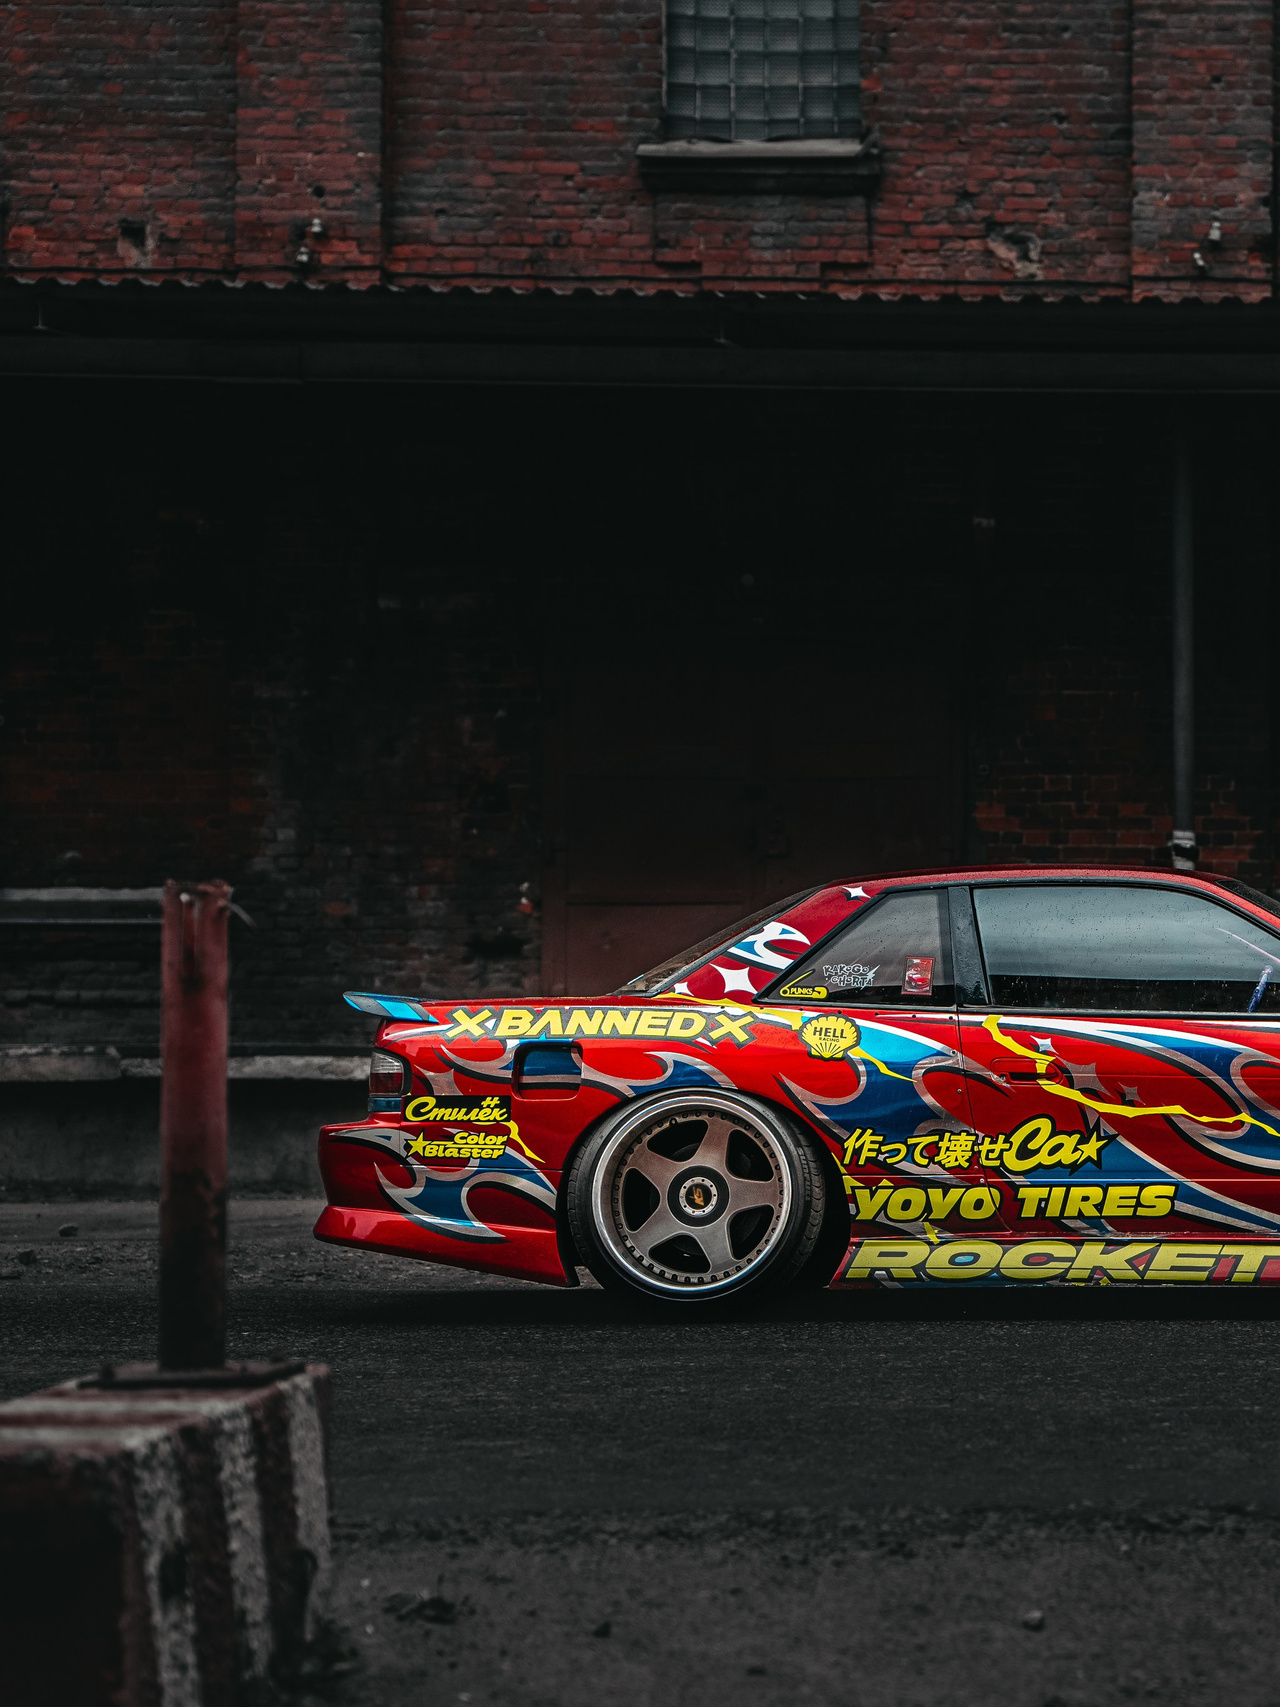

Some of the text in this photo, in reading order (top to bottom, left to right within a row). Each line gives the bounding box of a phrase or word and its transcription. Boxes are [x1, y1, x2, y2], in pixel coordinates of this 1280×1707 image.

[495, 1009, 706, 1038] BANNED
[813, 1026, 848, 1039] HELL
[453, 1131, 508, 1145] Color
[424, 1144, 505, 1159] Blaster
[855, 1185, 1176, 1221] YOYO TIRES
